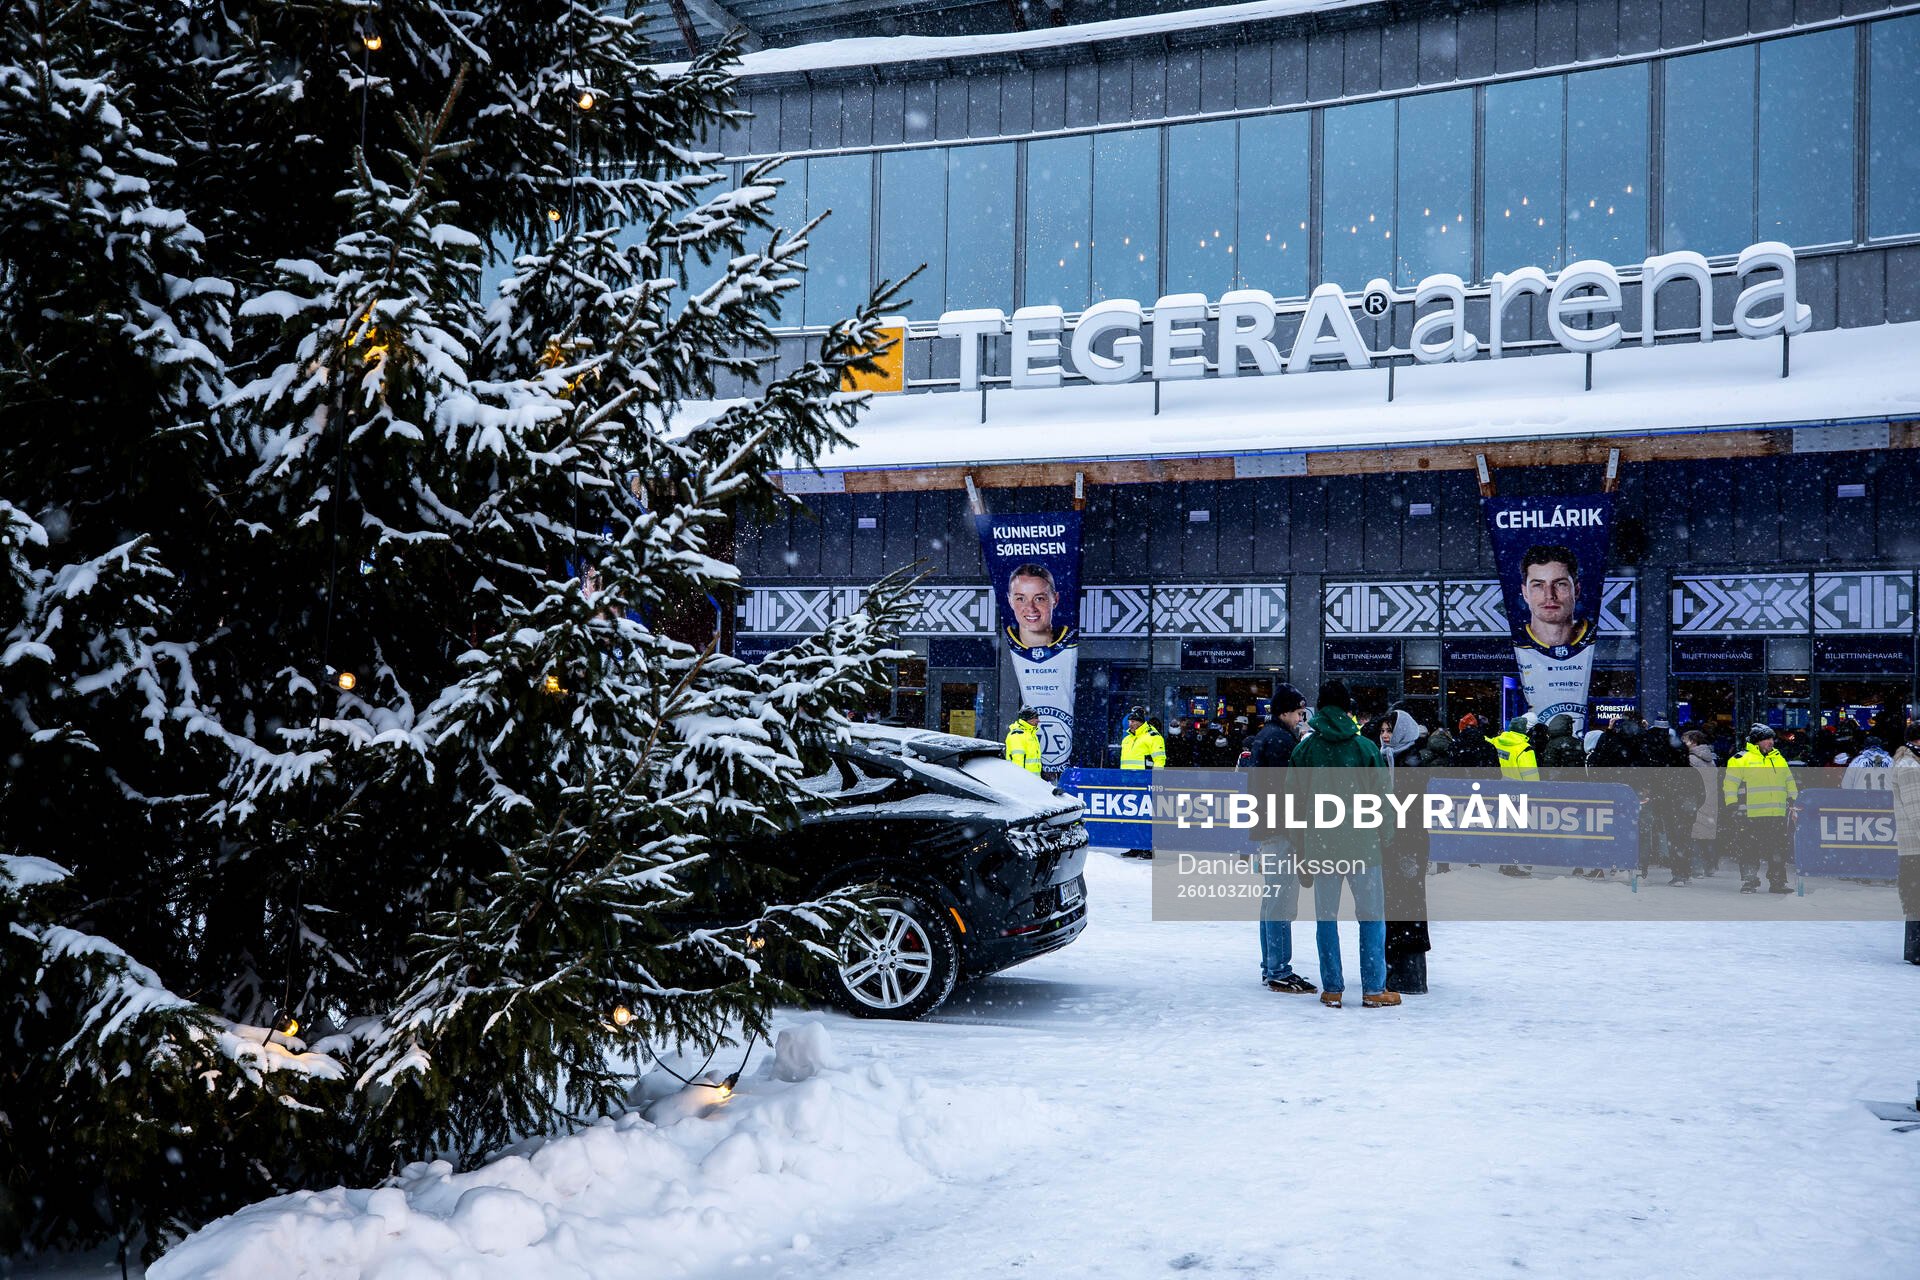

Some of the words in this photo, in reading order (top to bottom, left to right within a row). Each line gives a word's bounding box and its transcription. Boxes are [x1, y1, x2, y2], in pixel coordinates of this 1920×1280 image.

[1410, 242, 1811, 364] arena
[1495, 504, 1604, 529] CEHLÁRIK
[993, 524, 1066, 539] KUNNERUP
[996, 541, 1067, 556] SØRENSEN
[1332, 652, 1393, 660] BILJETTINNEHAVARE
[1681, 652, 1753, 660] BILJETTINNEHAVARE
[1825, 652, 1904, 660] BILJETTINNEHAVARE
[1147, 784, 1164, 792] 1919
[1863, 773, 1886, 790] 11
[1587, 807, 1614, 832] IF
[1820, 816, 1897, 842] LEKS
